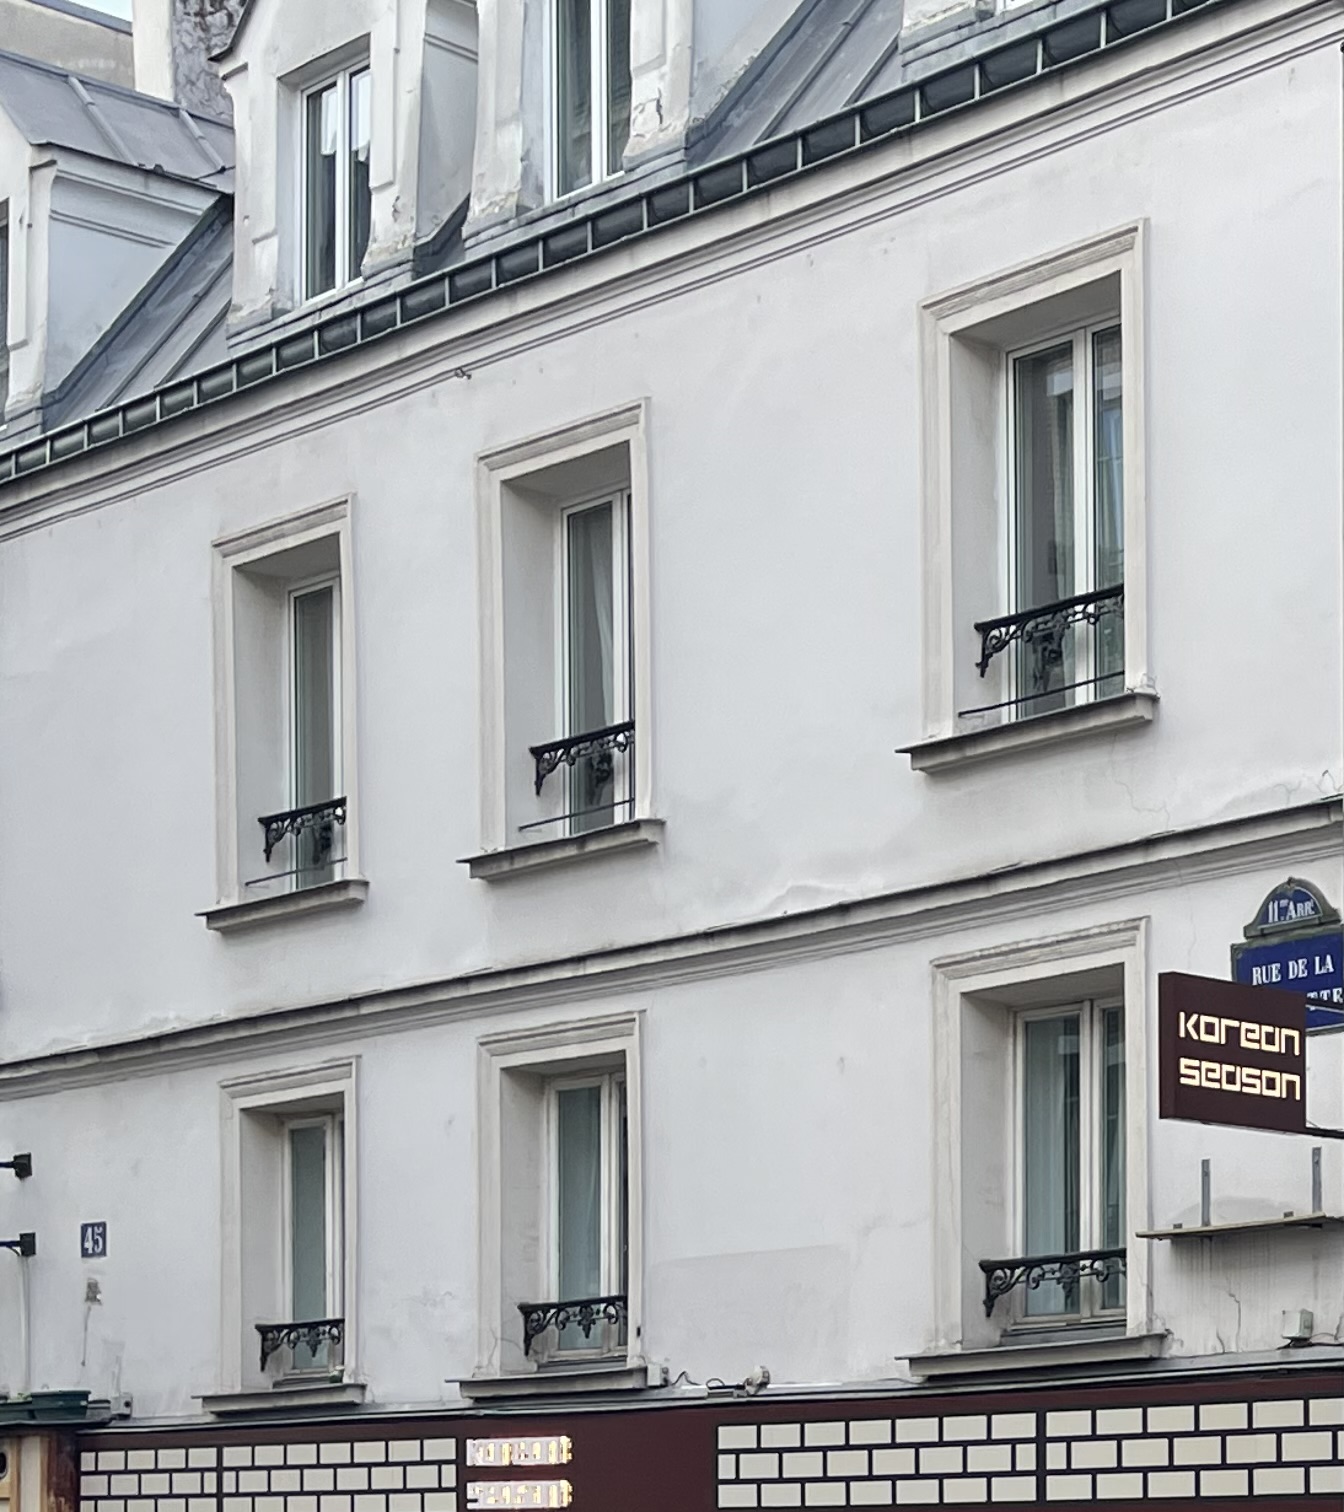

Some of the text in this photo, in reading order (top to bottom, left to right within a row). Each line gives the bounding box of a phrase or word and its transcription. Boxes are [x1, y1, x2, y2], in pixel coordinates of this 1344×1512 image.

[1252, 954, 1334, 986] RUE DE LA
[84, 1226, 103, 1254] 45
